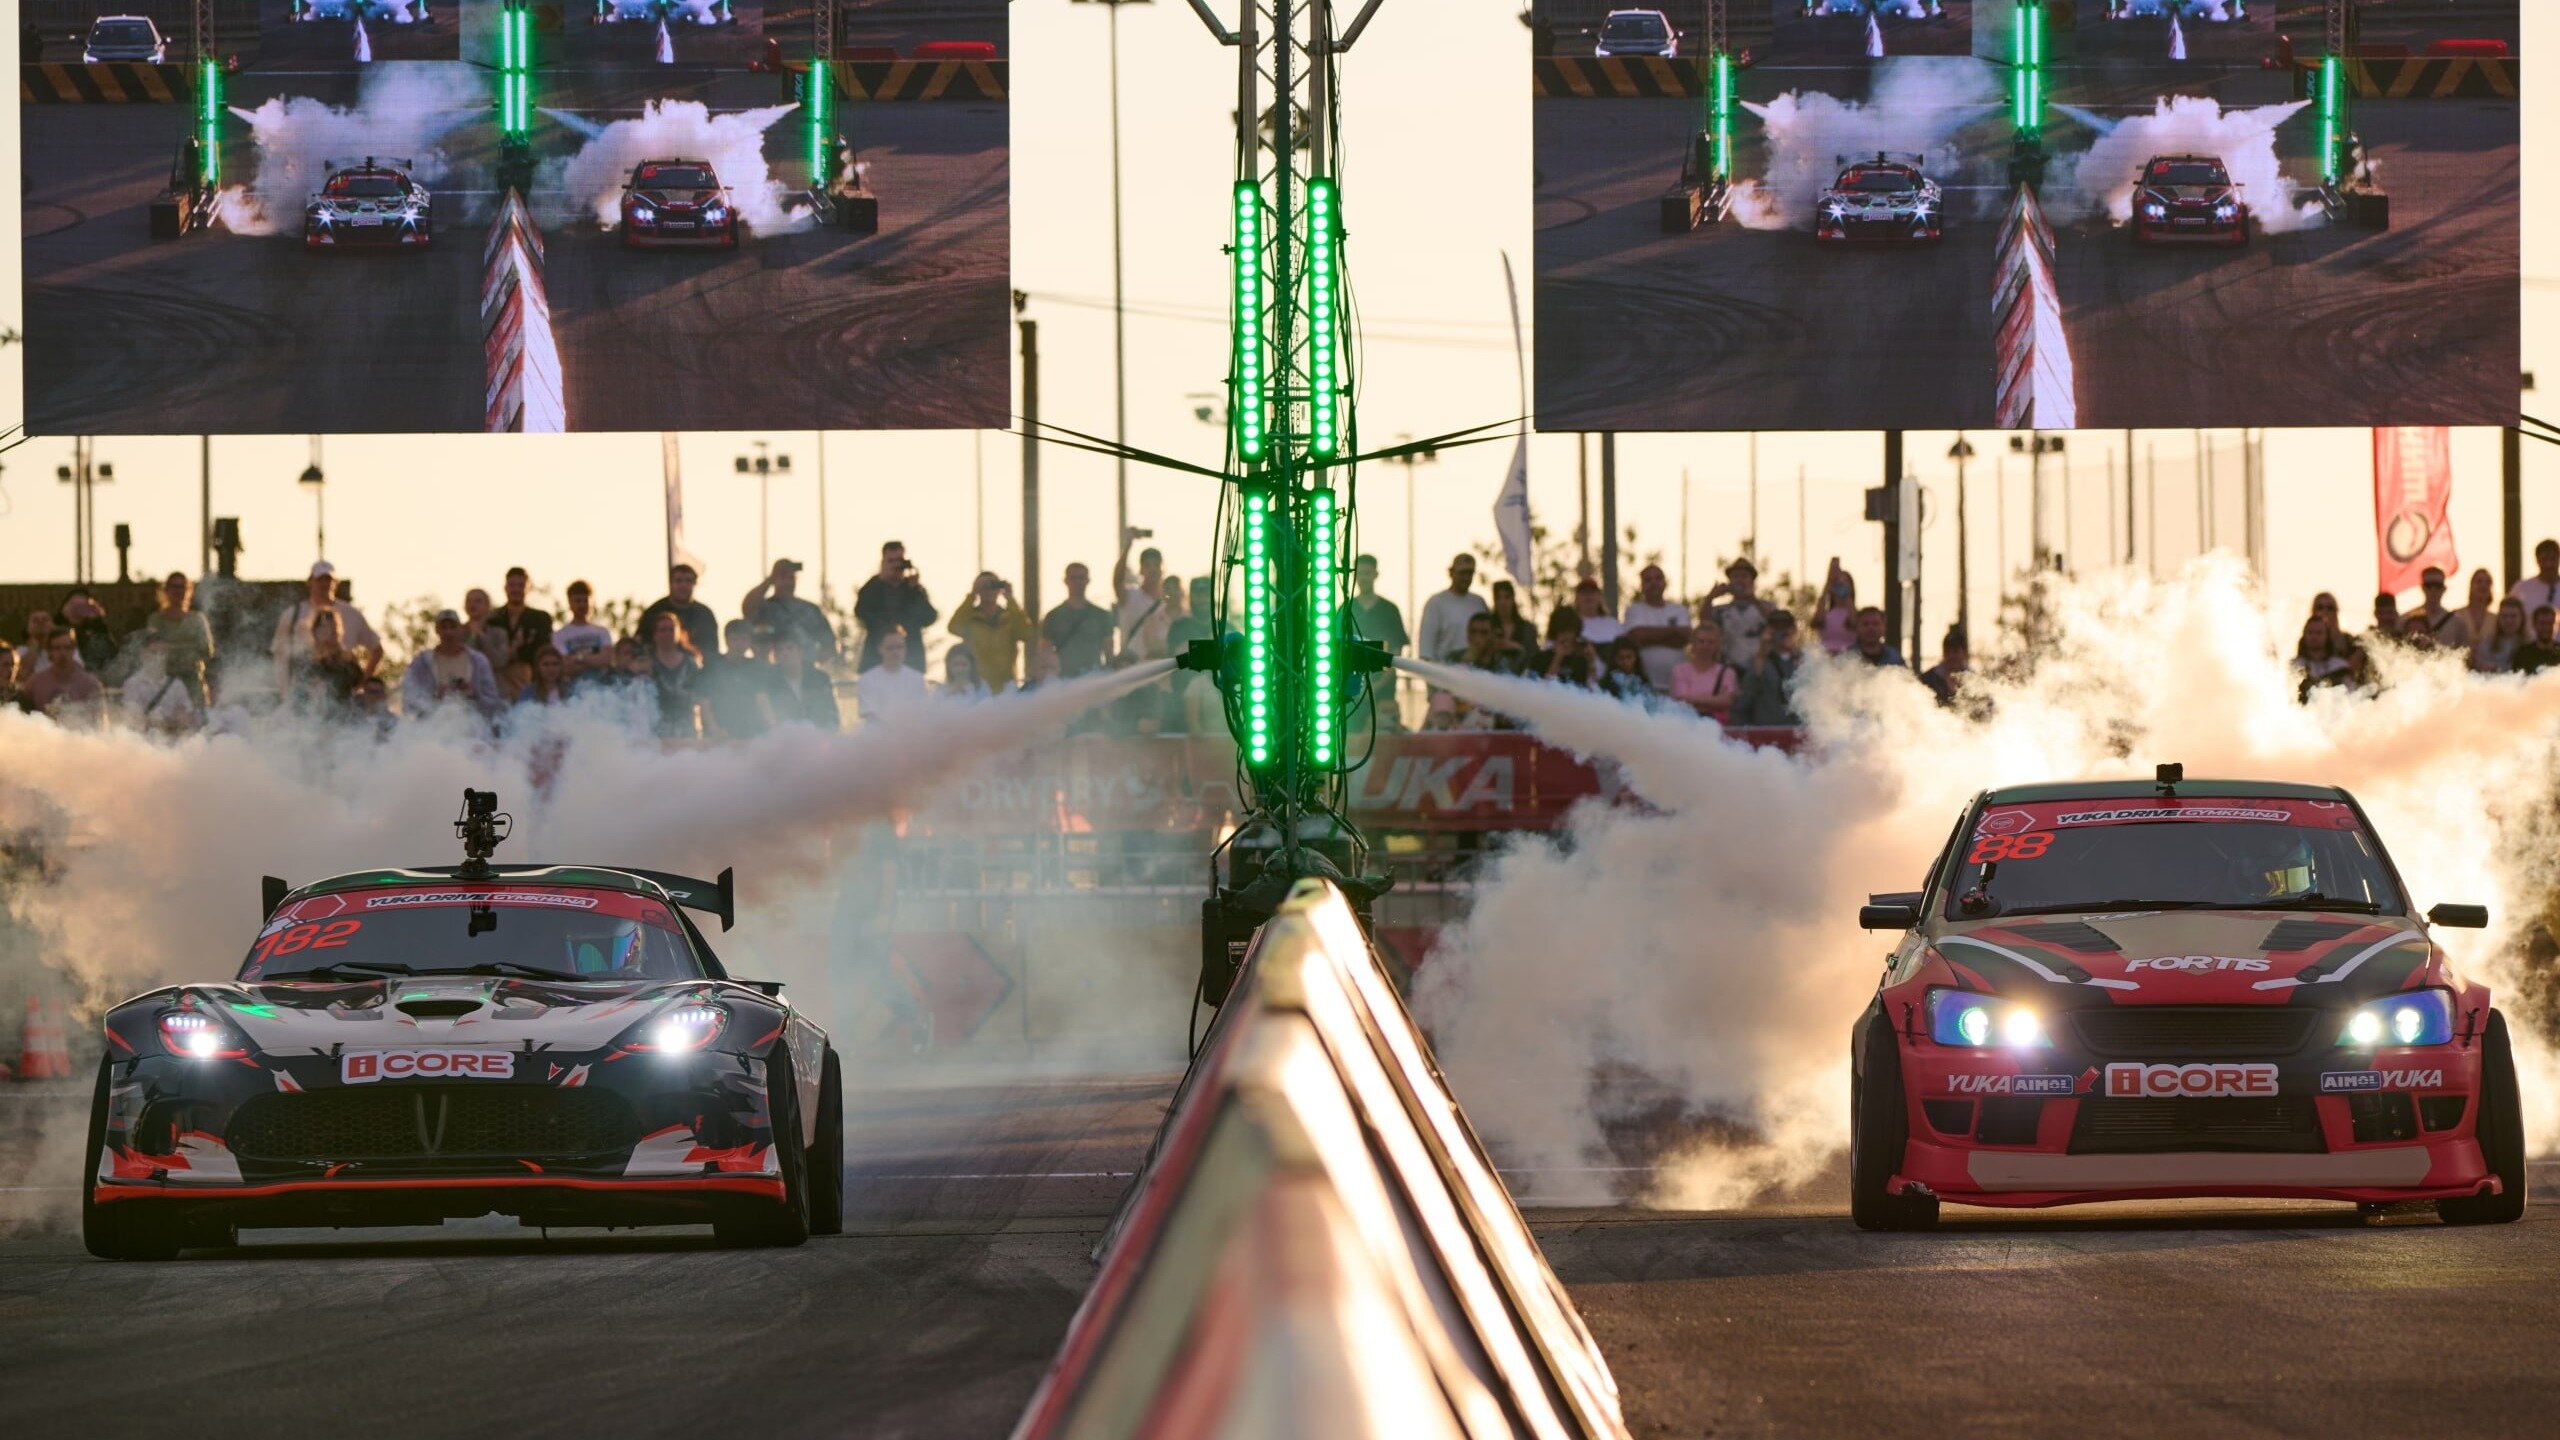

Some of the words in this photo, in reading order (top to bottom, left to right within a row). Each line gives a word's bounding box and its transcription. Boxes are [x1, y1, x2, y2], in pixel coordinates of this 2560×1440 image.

[1340, 755, 1514, 810] UKA
[2060, 812, 2113, 823] YUKA
[2115, 809, 2181, 818] DRIVE
[2184, 809, 2280, 819] GYMKHANA
[1968, 832, 2055, 864] 88
[370, 895, 421, 906] YUKA
[424, 893, 490, 902] DRIVE
[493, 893, 588, 906] GYMKHANA
[255, 920, 362, 964] 182
[2125, 955, 2273, 973] FORTIS
[1948, 1074, 2011, 1093] YUKA
[2014, 1078, 2071, 1092] AIMOL
[2323, 1075, 2379, 1089] AIMOL
[2382, 1069, 2443, 1088] YUKA
